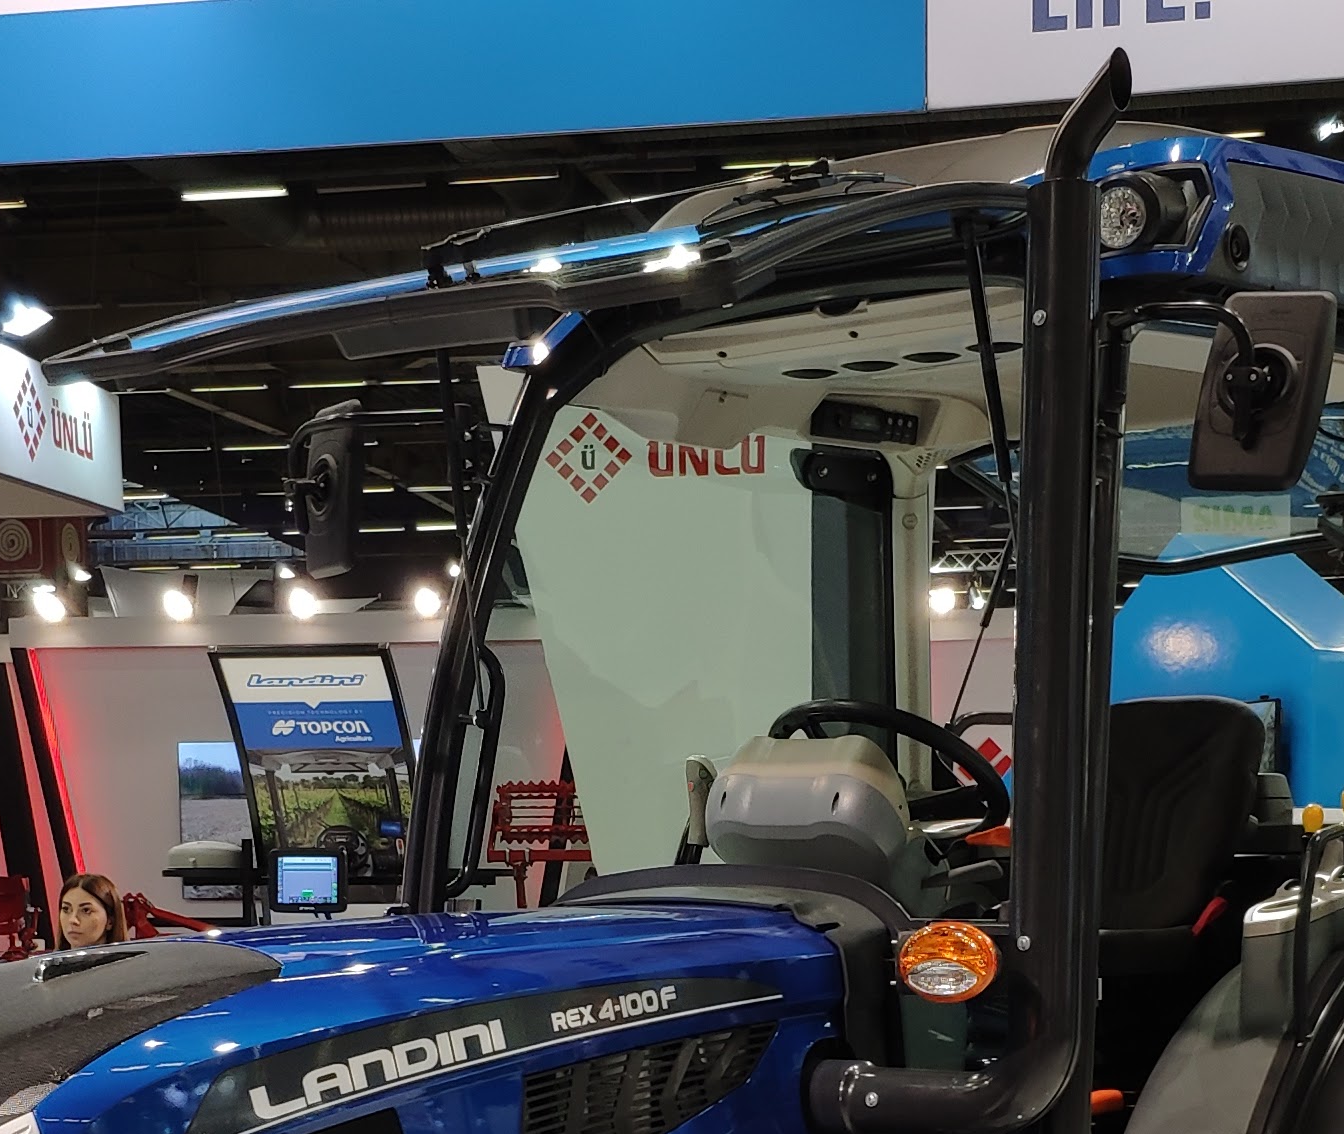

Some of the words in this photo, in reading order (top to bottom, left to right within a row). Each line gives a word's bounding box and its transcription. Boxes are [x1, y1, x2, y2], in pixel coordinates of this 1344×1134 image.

[51, 397, 94, 461] ÜNLÜ
[246, 673, 365, 688] Landini
[296, 720, 371, 734] TOPCON
[335, 735, 373, 743] Agriculture
[249, 1018, 508, 1120] LANDINI
[549, 1007, 597, 1034] REX
